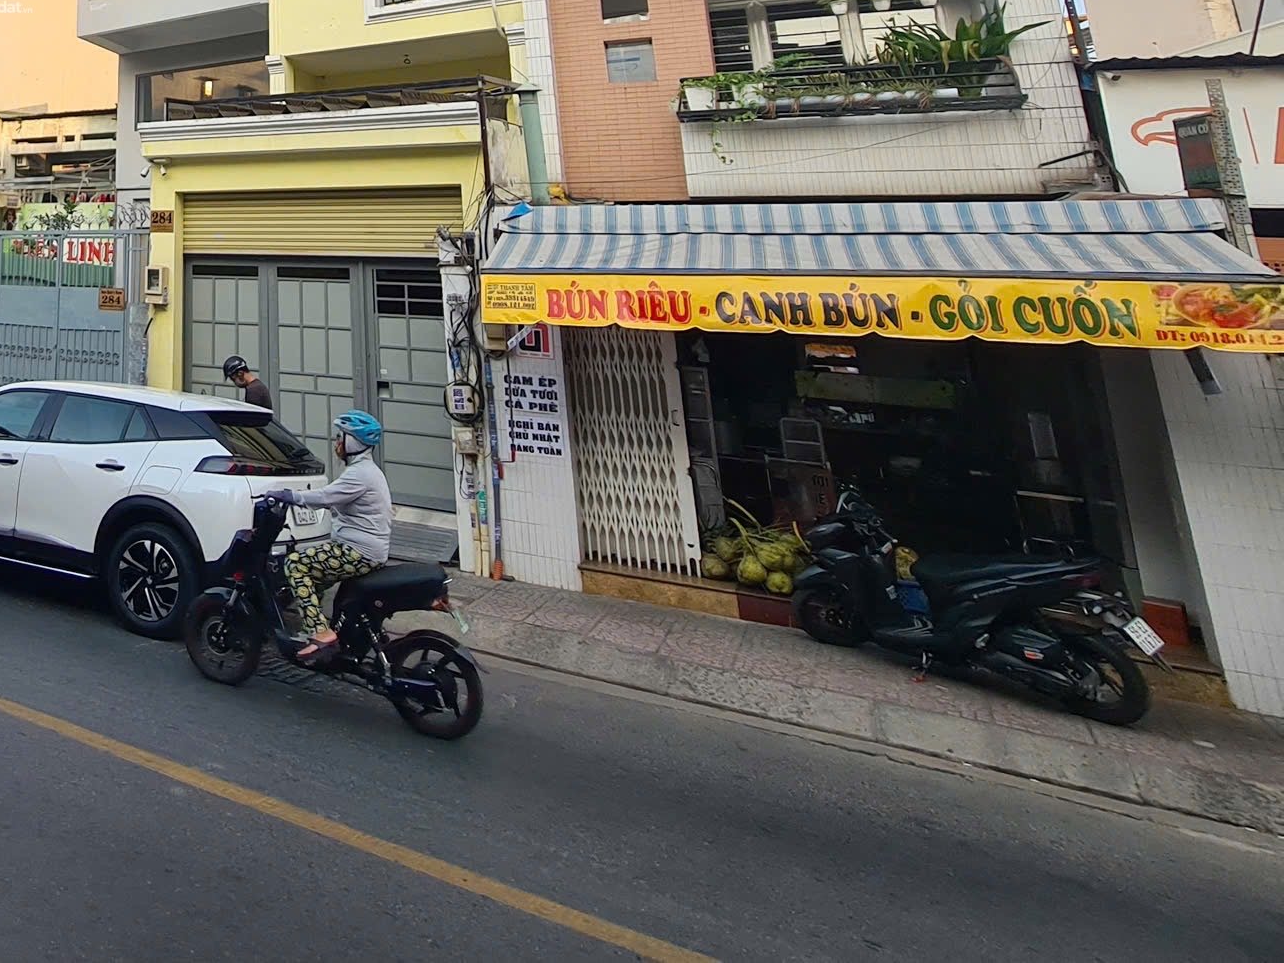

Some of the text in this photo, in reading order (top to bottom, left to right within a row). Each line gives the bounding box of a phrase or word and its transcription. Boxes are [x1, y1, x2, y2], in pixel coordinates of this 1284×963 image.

[151, 211, 173, 224] 284
[66, 240, 114, 264] LINH
[101, 295, 121, 305] 284
[546, 278, 1142, 340] BÚN RIÊU CANH BÚN GỎI CUỐN
[504, 374, 557, 387] CAM ÉP
[530, 388, 558, 401] TƯƠI
[504, 398, 558, 413] CÀ PHÊ
[537, 420, 560, 432] BÁN
